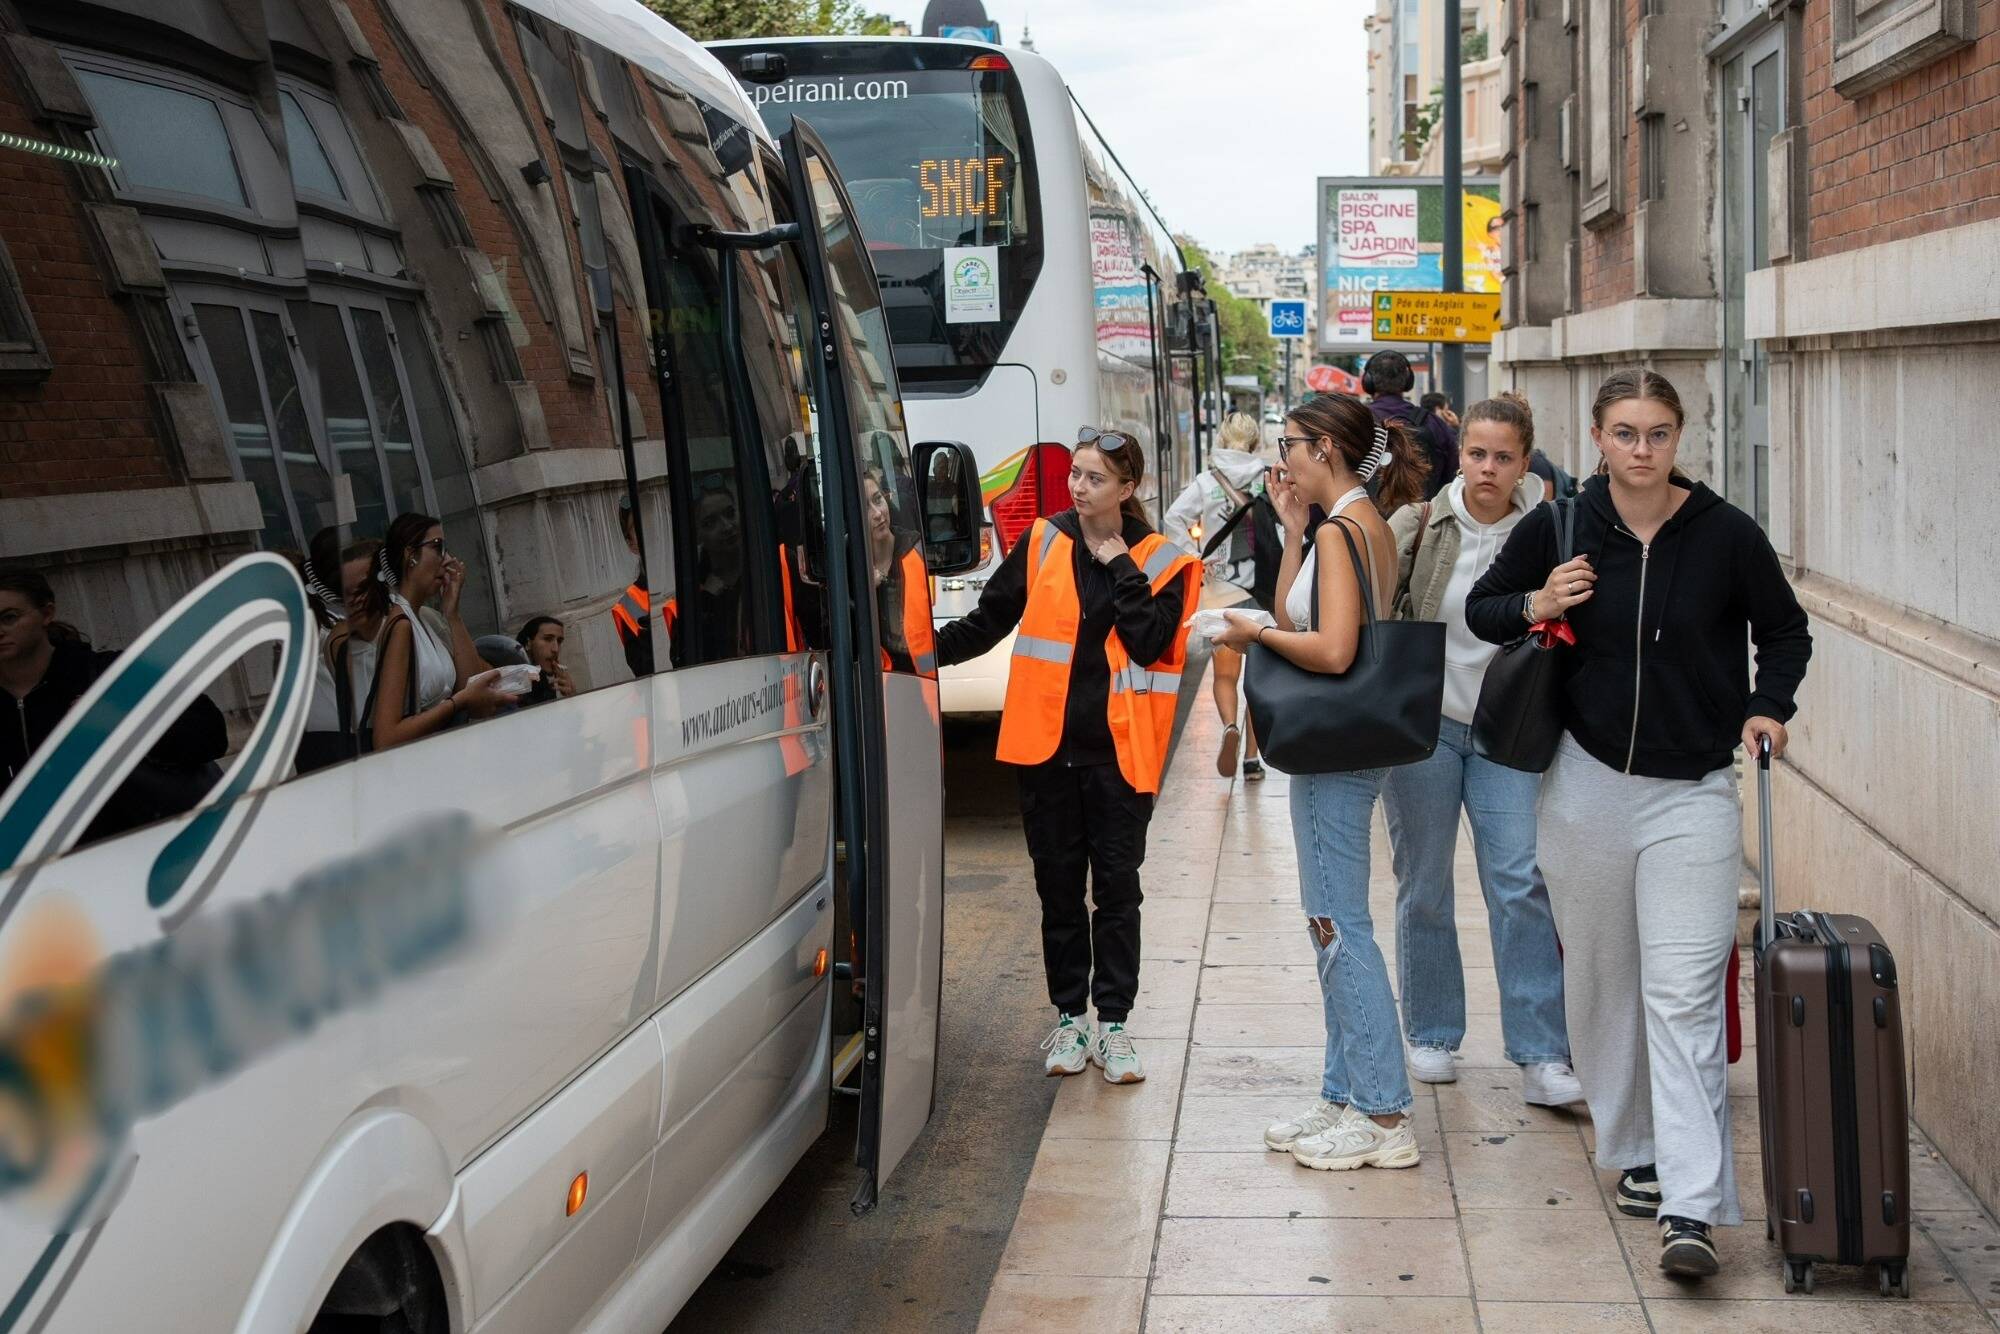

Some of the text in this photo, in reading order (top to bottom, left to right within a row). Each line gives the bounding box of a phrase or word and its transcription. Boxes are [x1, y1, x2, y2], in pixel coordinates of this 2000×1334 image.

[920, 157, 1004, 217] SNCF
[1341, 192, 1378, 201] SALON
[1341, 203, 1416, 218] PISCINE
[1341, 220, 1377, 235] SPA
[1349, 236, 1416, 251] JARDIN
[1338, 275, 1390, 292] NICE
[1415, 298, 1430, 309] des
[1433, 298, 1465, 312] Anglais
[1346, 1132, 1364, 1146] N
